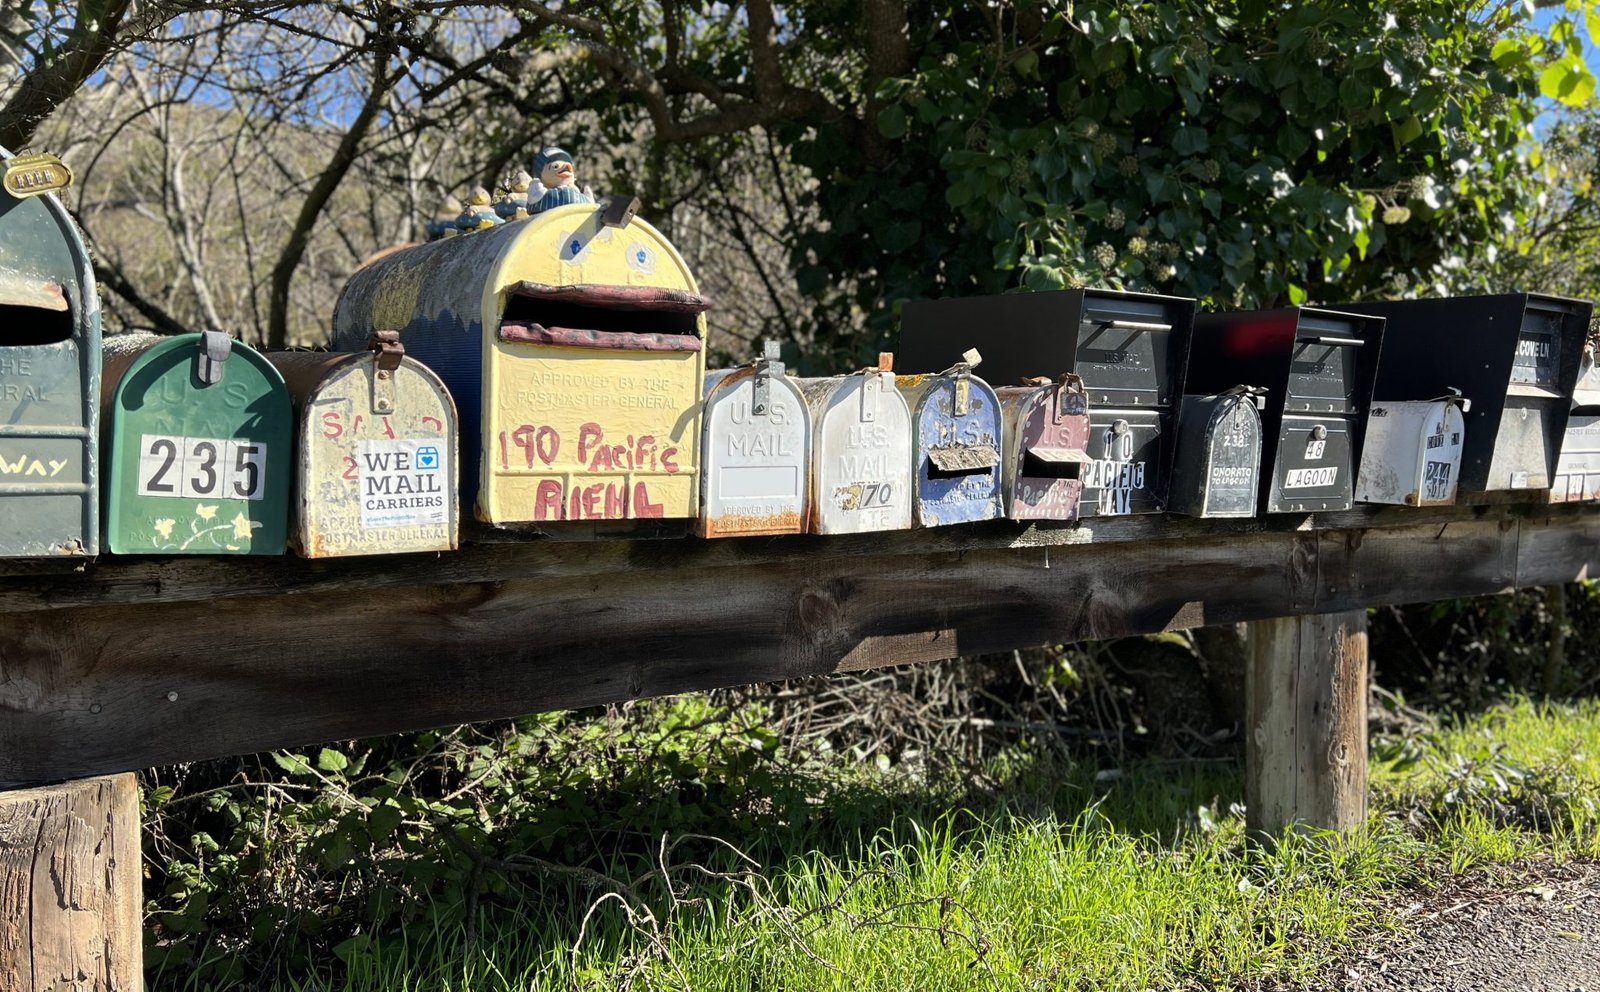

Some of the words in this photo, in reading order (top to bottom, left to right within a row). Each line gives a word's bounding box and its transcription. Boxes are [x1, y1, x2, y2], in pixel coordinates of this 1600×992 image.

[1519, 339, 1540, 357] COVE
[530, 372, 611, 389] APPROVED
[619, 376, 635, 390] BY
[644, 378, 671, 392] THE
[516, 390, 611, 408] POSTMASTER
[618, 396, 680, 410] GENERAL
[498, 424, 561, 470] 190
[727, 432, 793, 457] MAIL
[1307, 441, 1324, 458] 48
[146, 438, 260, 497] 235
[363, 452, 410, 472] WE
[838, 454, 897, 481] MAIL
[1212, 466, 1252, 477] ONORATO
[1083, 461, 1144, 488] PACIFIC
[1286, 469, 1337, 486] LAGOON
[1426, 463, 1450, 482] 244
[366, 473, 441, 496] MAIL
[366, 496, 443, 511] CARRIERS
[863, 483, 892, 507] 70
[1100, 488, 1130, 513] WAY
